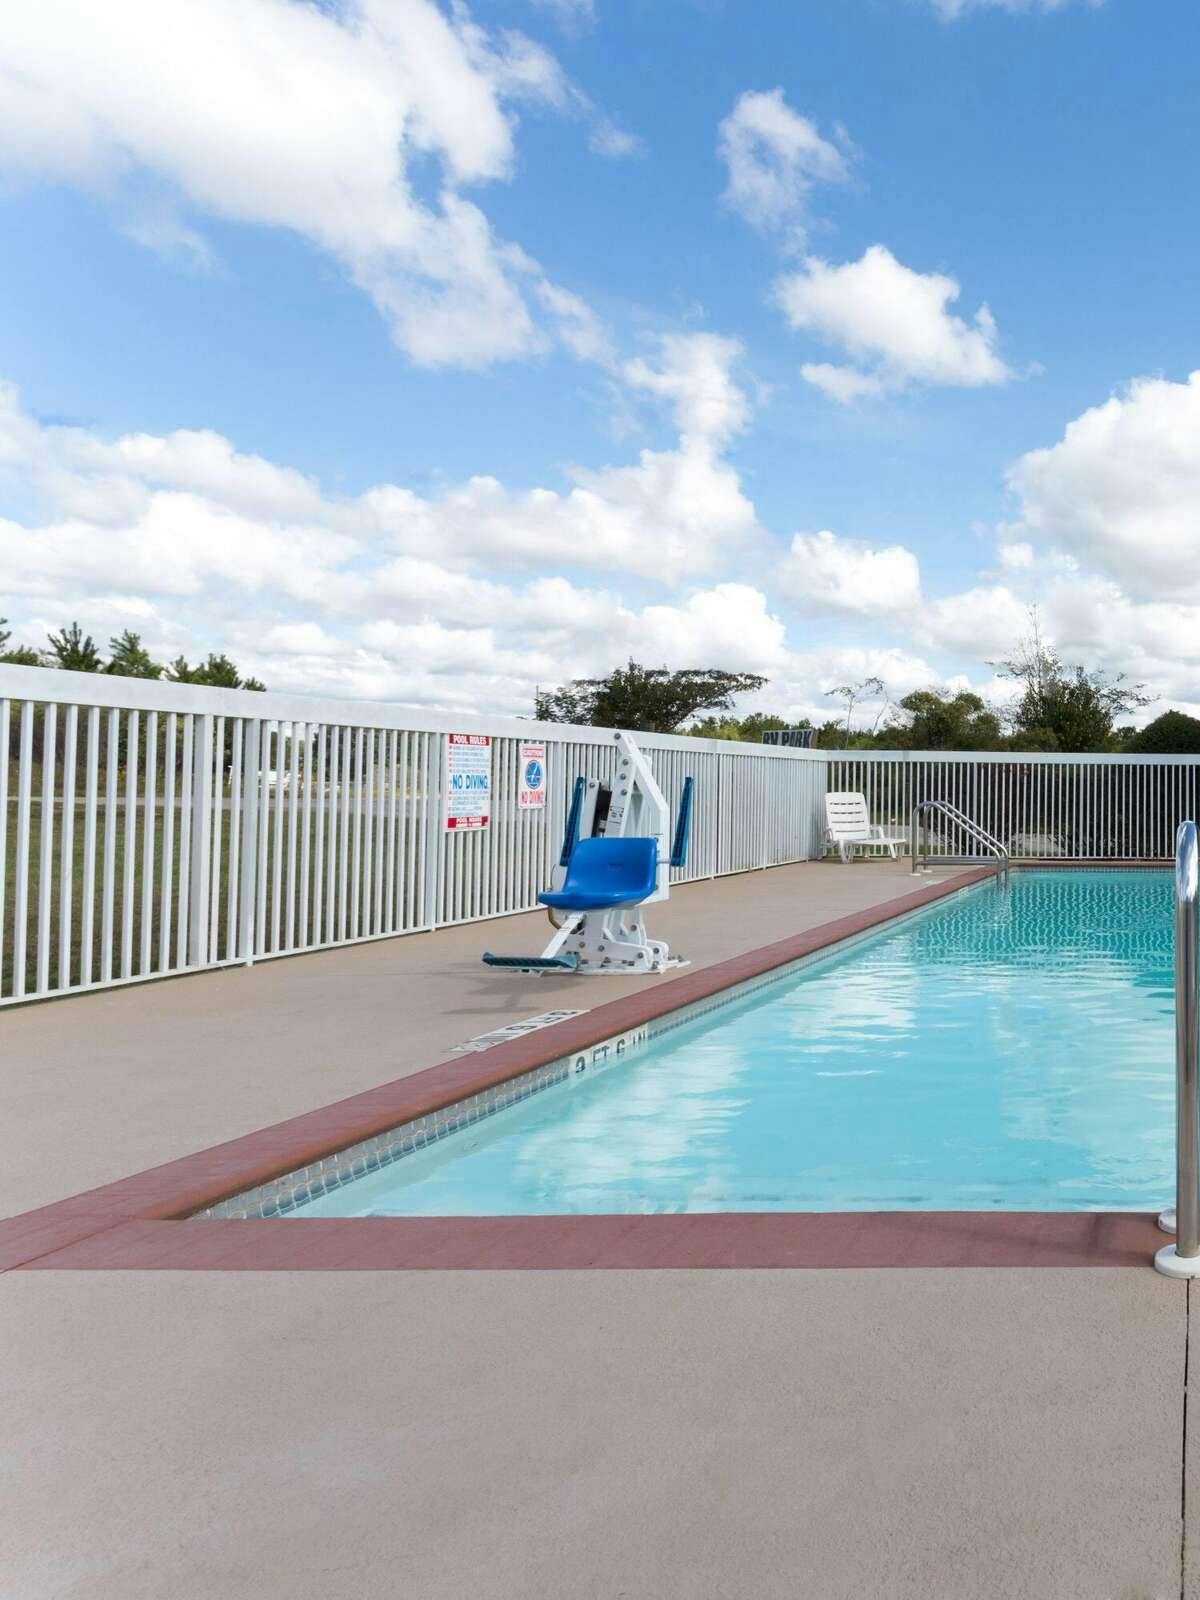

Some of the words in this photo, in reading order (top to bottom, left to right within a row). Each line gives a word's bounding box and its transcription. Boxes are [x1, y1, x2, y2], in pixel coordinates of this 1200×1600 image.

[453, 734, 469, 744] POOL
[470, 735, 487, 745] RULES
[763, 731, 779, 744] RV
[781, 731, 811, 748] PARK
[453, 774, 463, 790] NO
[465, 774, 488, 790] DIVING
